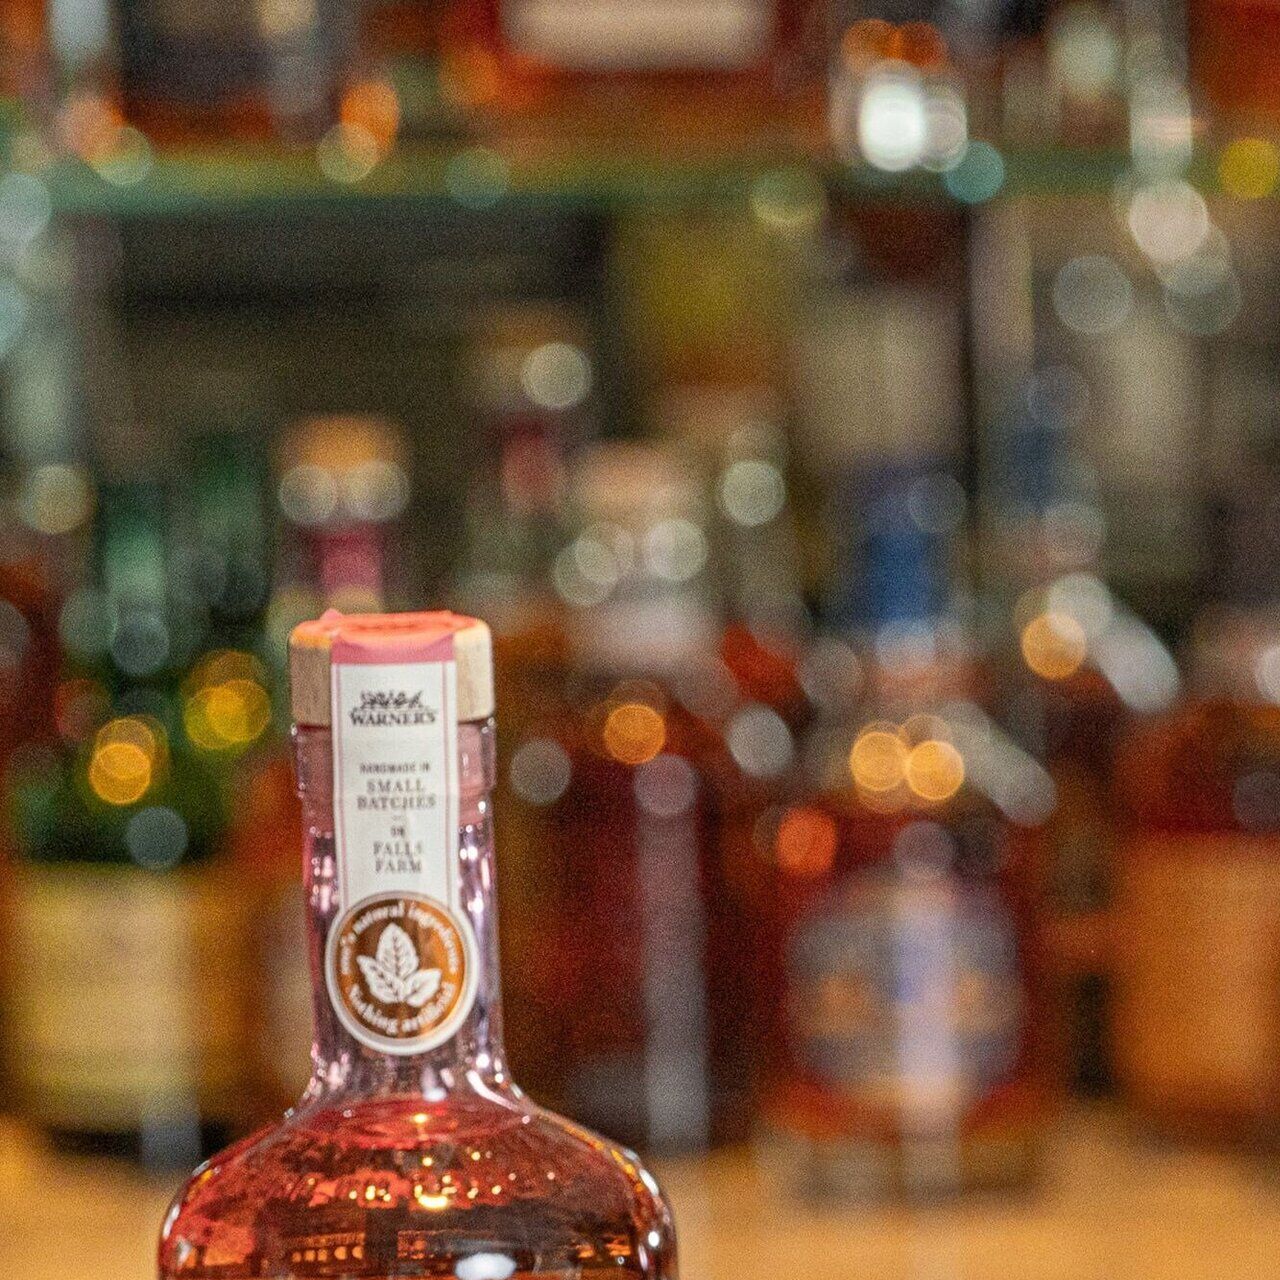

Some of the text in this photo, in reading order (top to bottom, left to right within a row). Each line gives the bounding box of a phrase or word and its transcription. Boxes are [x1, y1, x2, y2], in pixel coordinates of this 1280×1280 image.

[366, 779, 424, 793] SMALL
[357, 795, 436, 811] BATCHES
[375, 859, 422, 874] FARM
